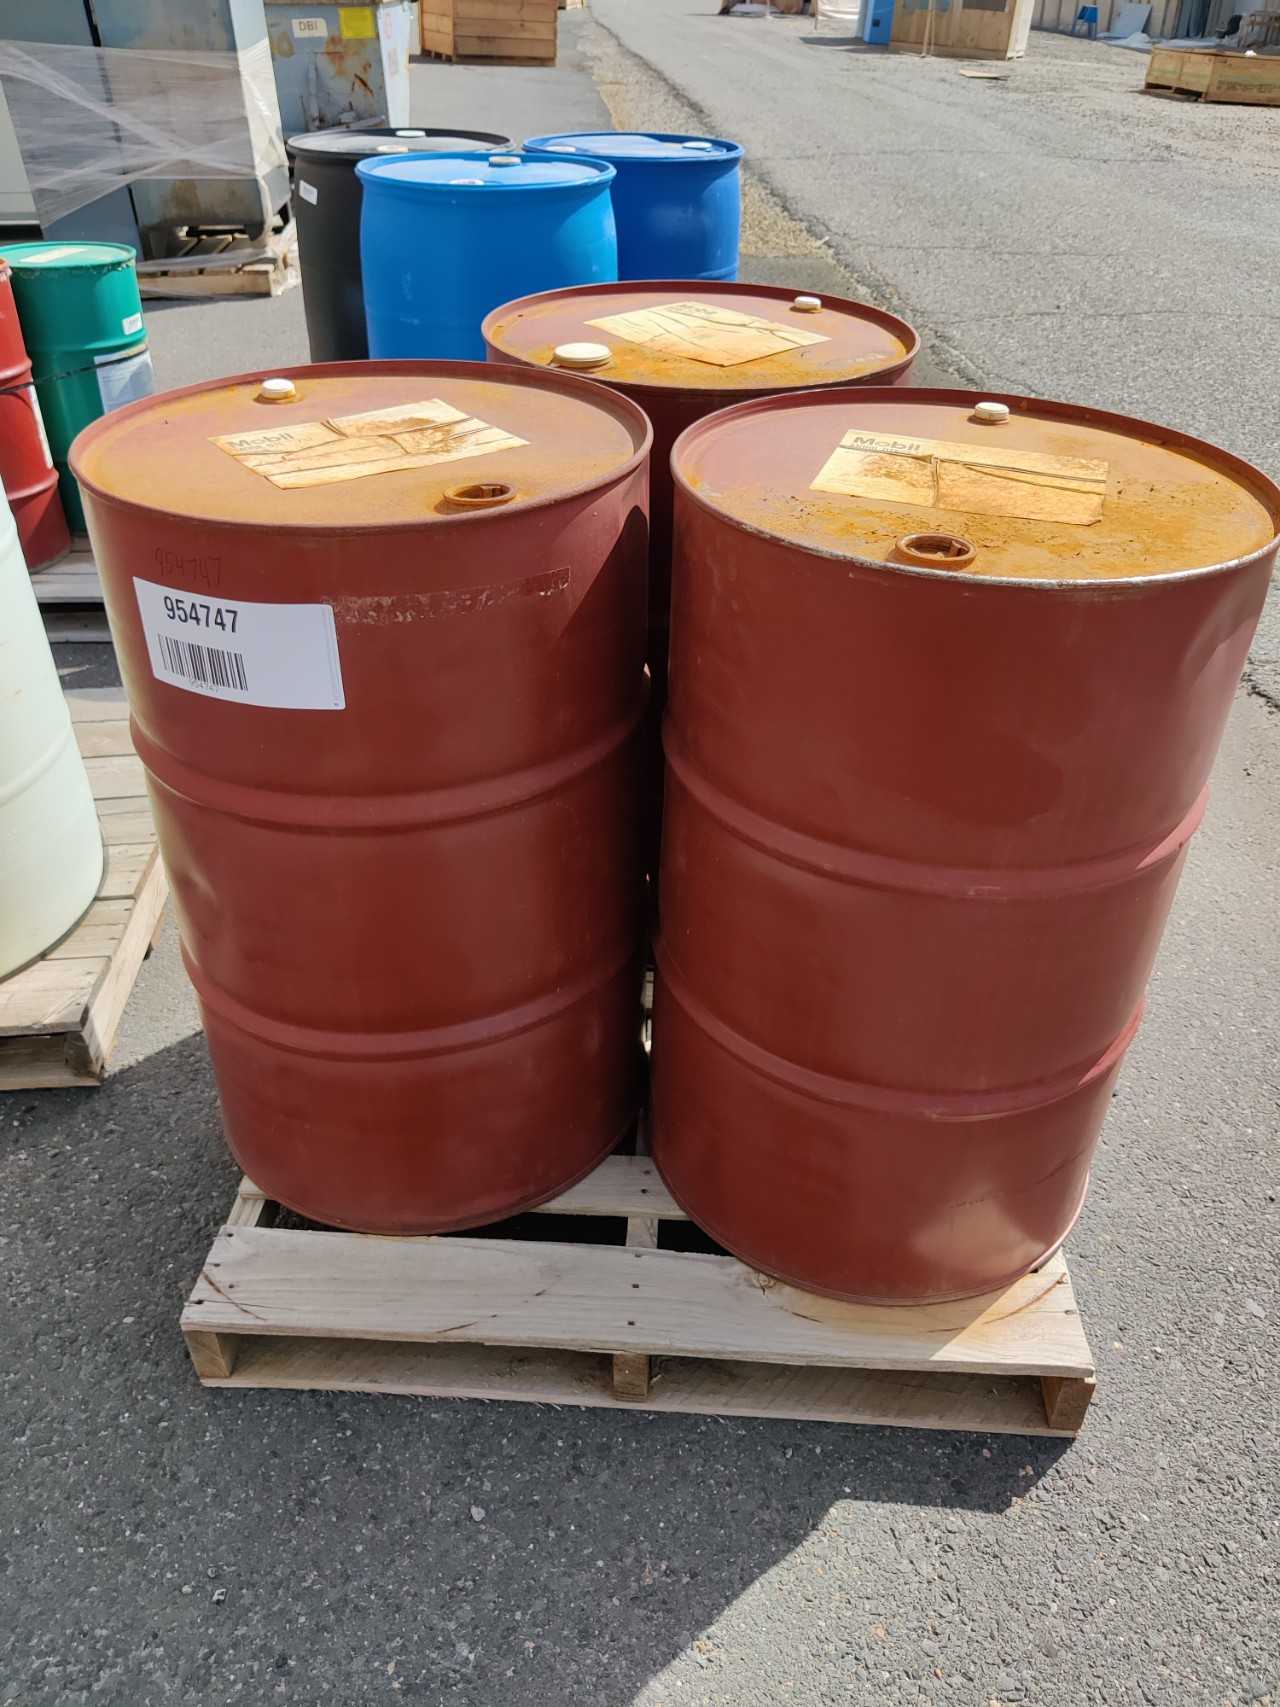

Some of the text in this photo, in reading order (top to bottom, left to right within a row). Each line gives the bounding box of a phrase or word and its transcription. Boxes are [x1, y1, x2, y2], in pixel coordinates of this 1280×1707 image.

[226, 433, 295, 447] Mobil
[854, 436, 920, 451] Mobil
[155, 547, 221, 588] 954747
[163, 596, 238, 633] 954747
